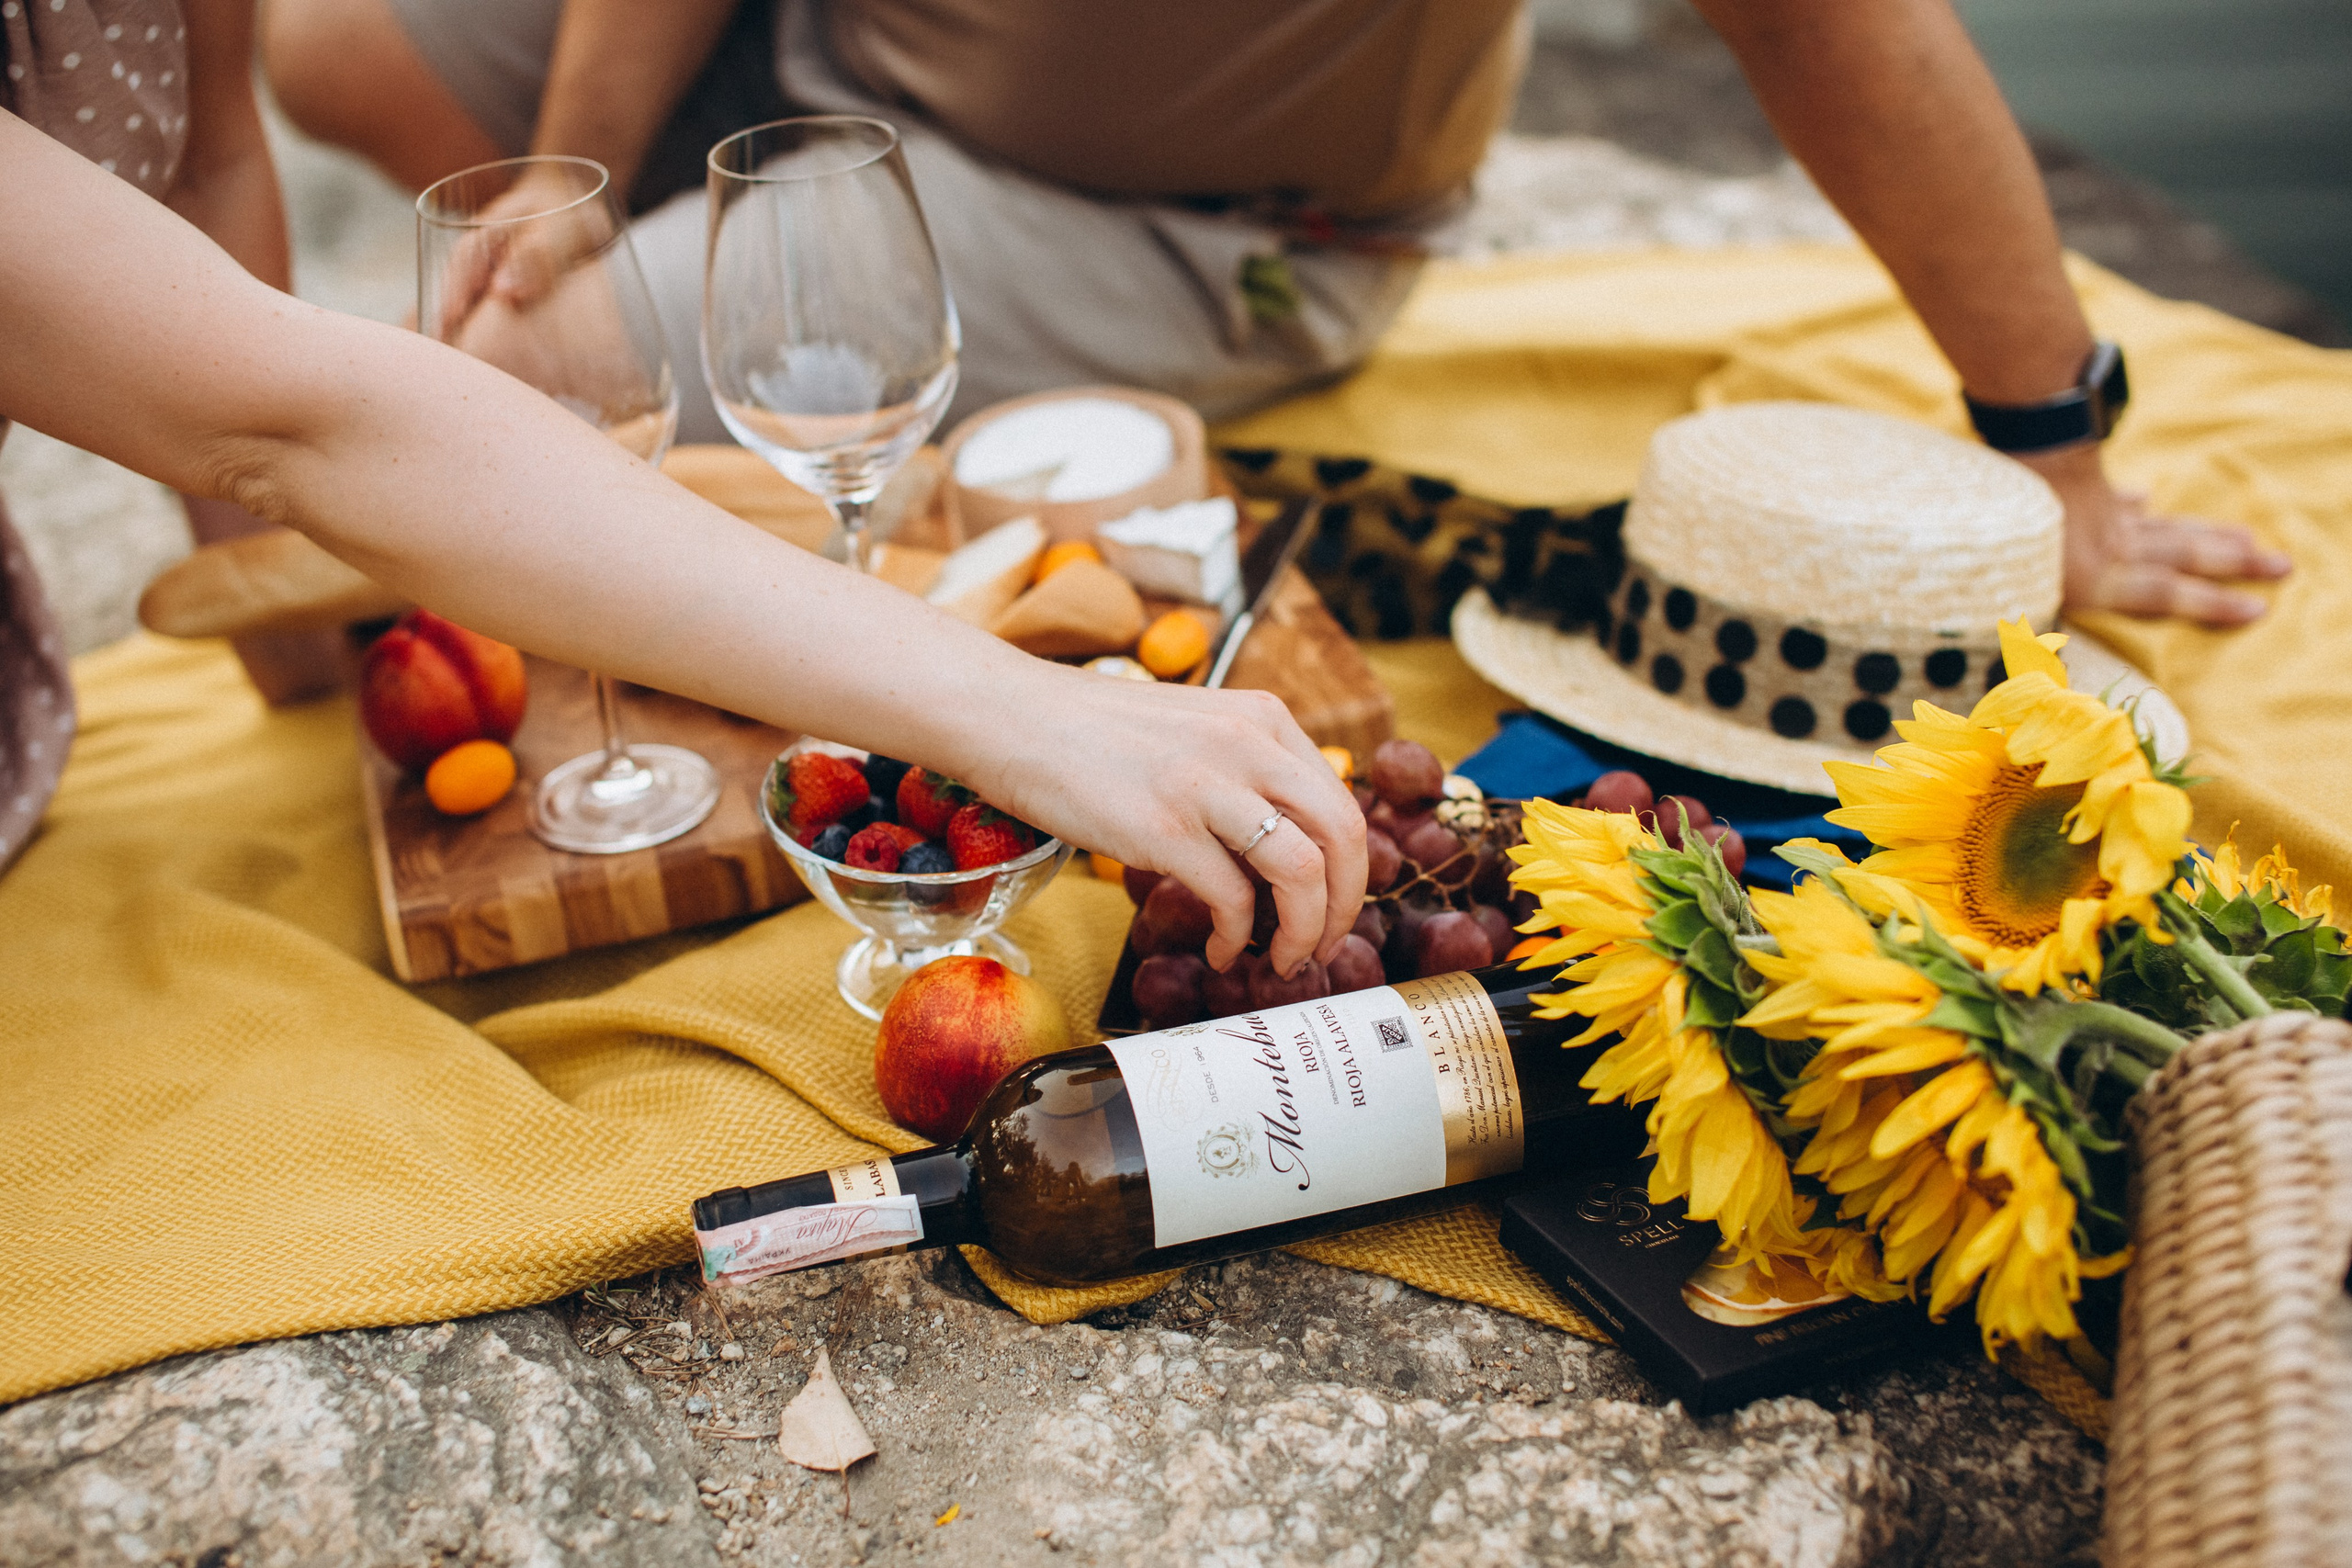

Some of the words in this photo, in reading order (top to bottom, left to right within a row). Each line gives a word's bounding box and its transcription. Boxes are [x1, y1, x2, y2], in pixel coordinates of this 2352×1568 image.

[1310, 1030, 1322, 1048] ORIGEN
[1315, 1003, 1351, 1054] ALAVESA
[1381, 1025, 1402, 1040] RIOJA
[1408, 993, 1450, 1074] BLANCO
[1471, 1026, 1486, 1052] contaban
[1193, 1045, 1206, 1066] 1964
[1293, 1031, 1319, 1073] RIOJA
[1318, 1048, 1325, 1056] DE
[1482, 1053, 1491, 1064] que
[1455, 1055, 1466, 1075] Rioja
[1202, 1071, 1219, 1103] DESDE
[1321, 1056, 1340, 1104] DENOMINACIÓN
[1342, 1056, 1366, 1108] RIOJA
[1463, 1076, 1467, 1084] en
[1215, 1011, 1310, 1190] Montebue
[1462, 1085, 1471, 1103] 1786,
[1474, 1087, 1487, 1115] Manuel
[1486, 1084, 1501, 1114] potencial
[1501, 1089, 1512, 1107] logró
[1465, 1105, 1474, 1117] año
[1467, 1125, 1477, 1144] Hasta
[1478, 1116, 1488, 1133] Don
[838, 1168, 854, 1190] SINCE
[1618, 1220, 1685, 1247] SPELL
